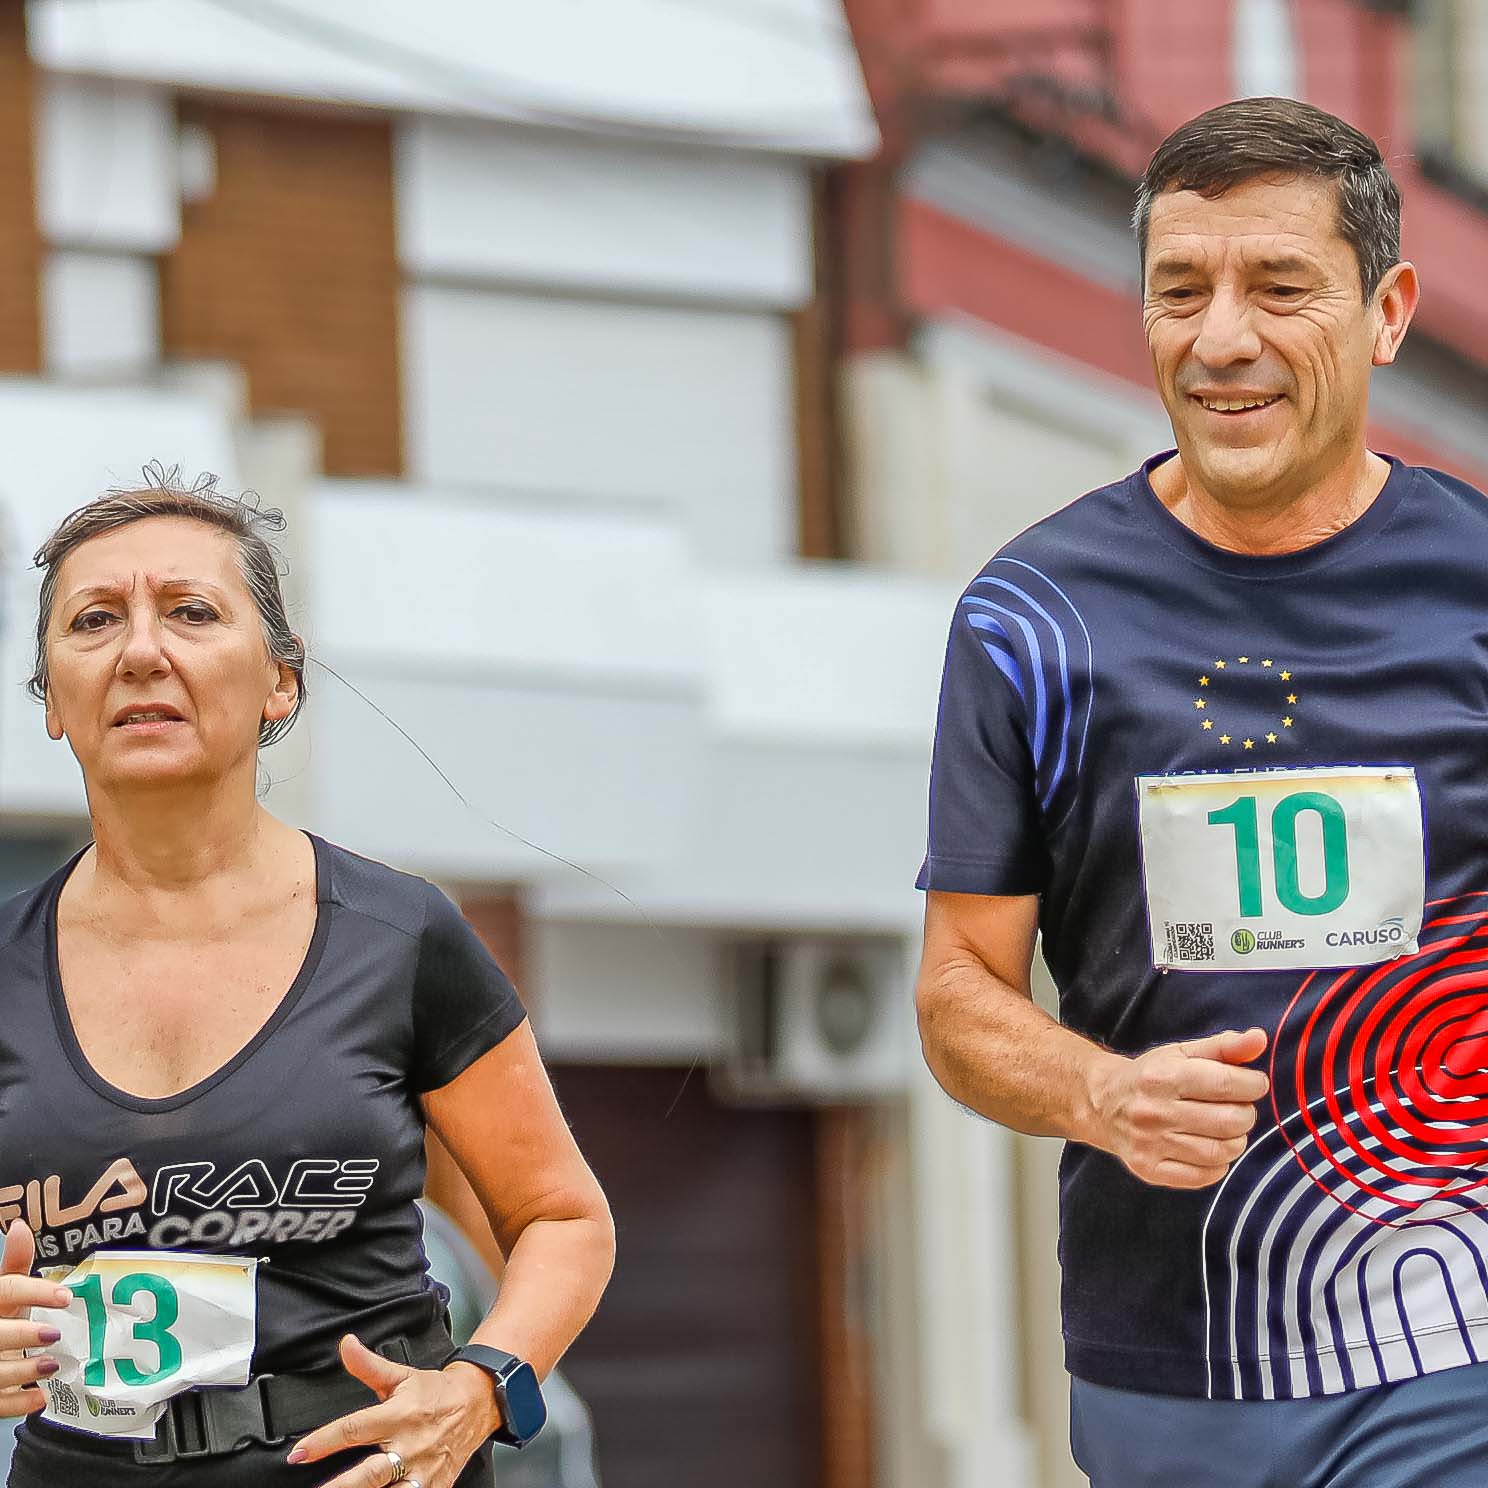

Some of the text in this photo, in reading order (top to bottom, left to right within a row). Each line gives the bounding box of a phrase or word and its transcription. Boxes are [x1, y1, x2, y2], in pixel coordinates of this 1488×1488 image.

[1206, 790, 1350, 918] 10
[1256, 939, 1305, 951] RUNNER'S
[1257, 930, 1283, 941] CLUB
[1325, 926, 1402, 948] CARUSO
[151, 1158, 380, 1217] RACE
[64, 1211, 147, 1252] PARA
[71, 1274, 182, 1387] 13
